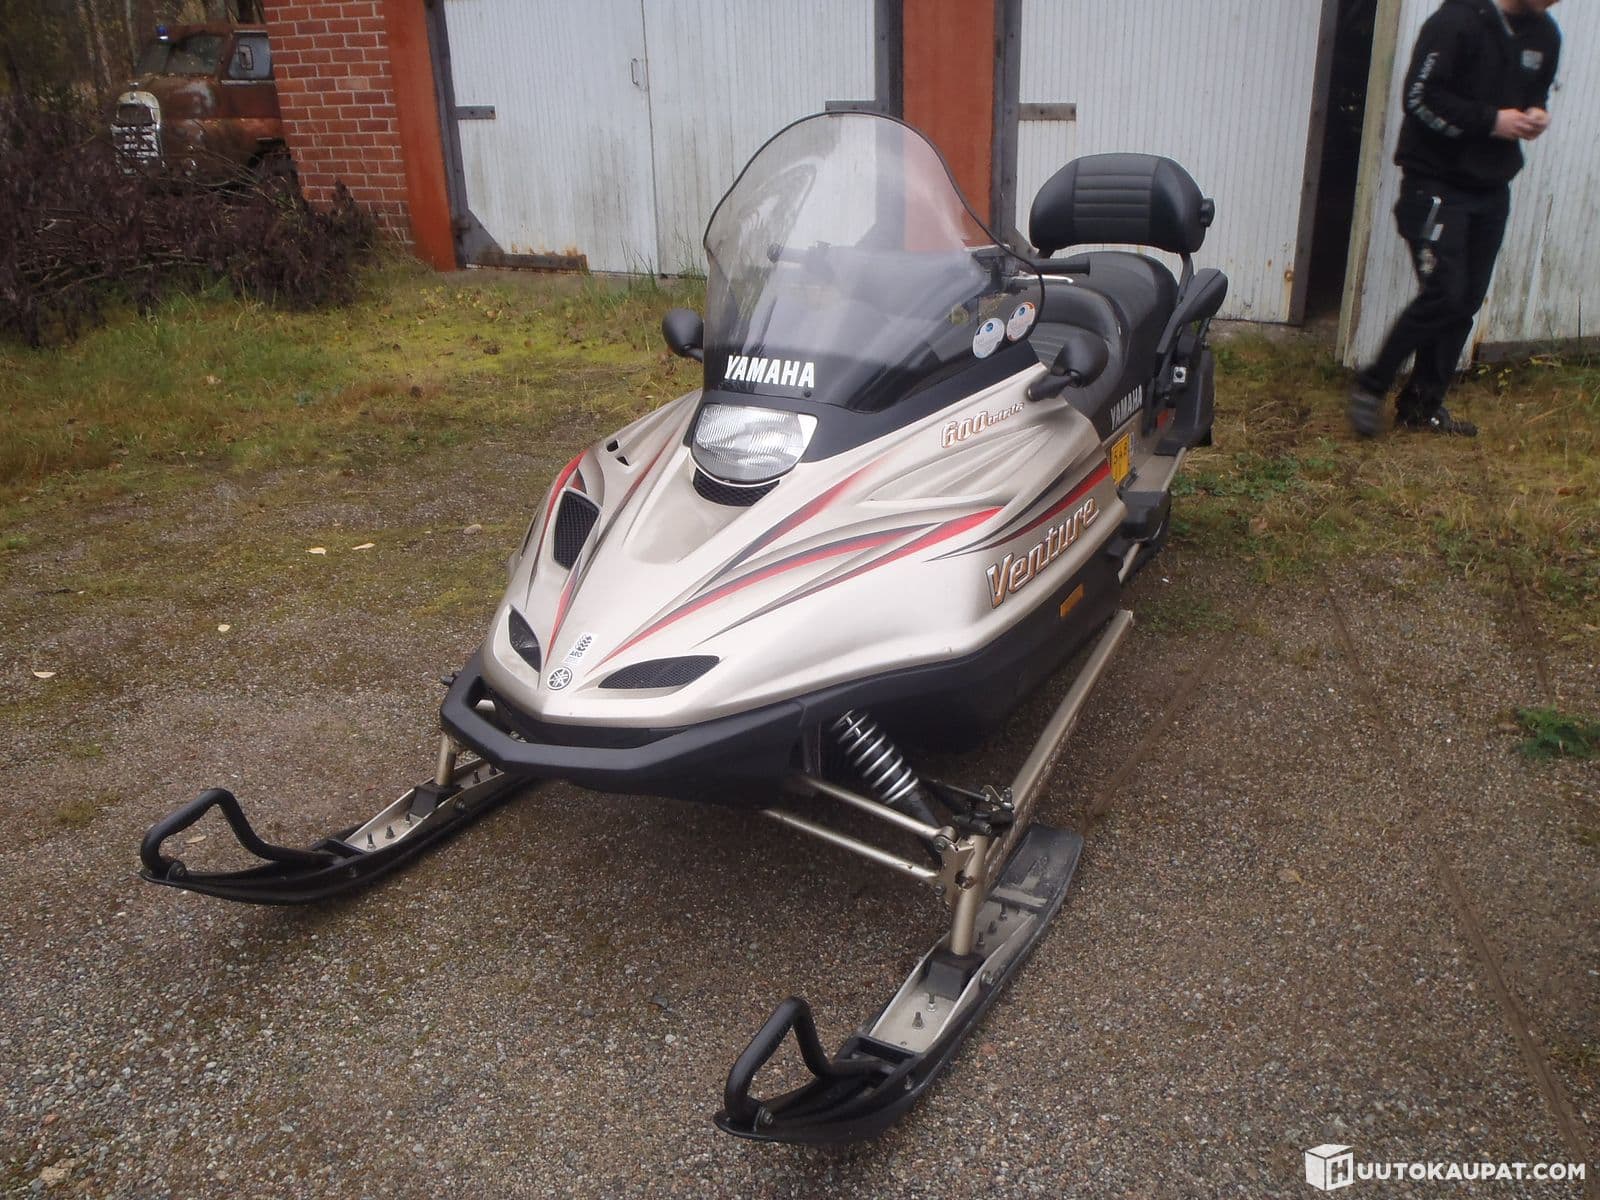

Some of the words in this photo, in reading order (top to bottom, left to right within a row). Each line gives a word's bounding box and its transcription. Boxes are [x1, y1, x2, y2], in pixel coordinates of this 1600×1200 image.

[724, 355, 815, 388] YAMAHA
[1110, 384, 1143, 431] YAMAHA
[941, 411, 988, 448] 600
[985, 497, 1100, 609] Venture
